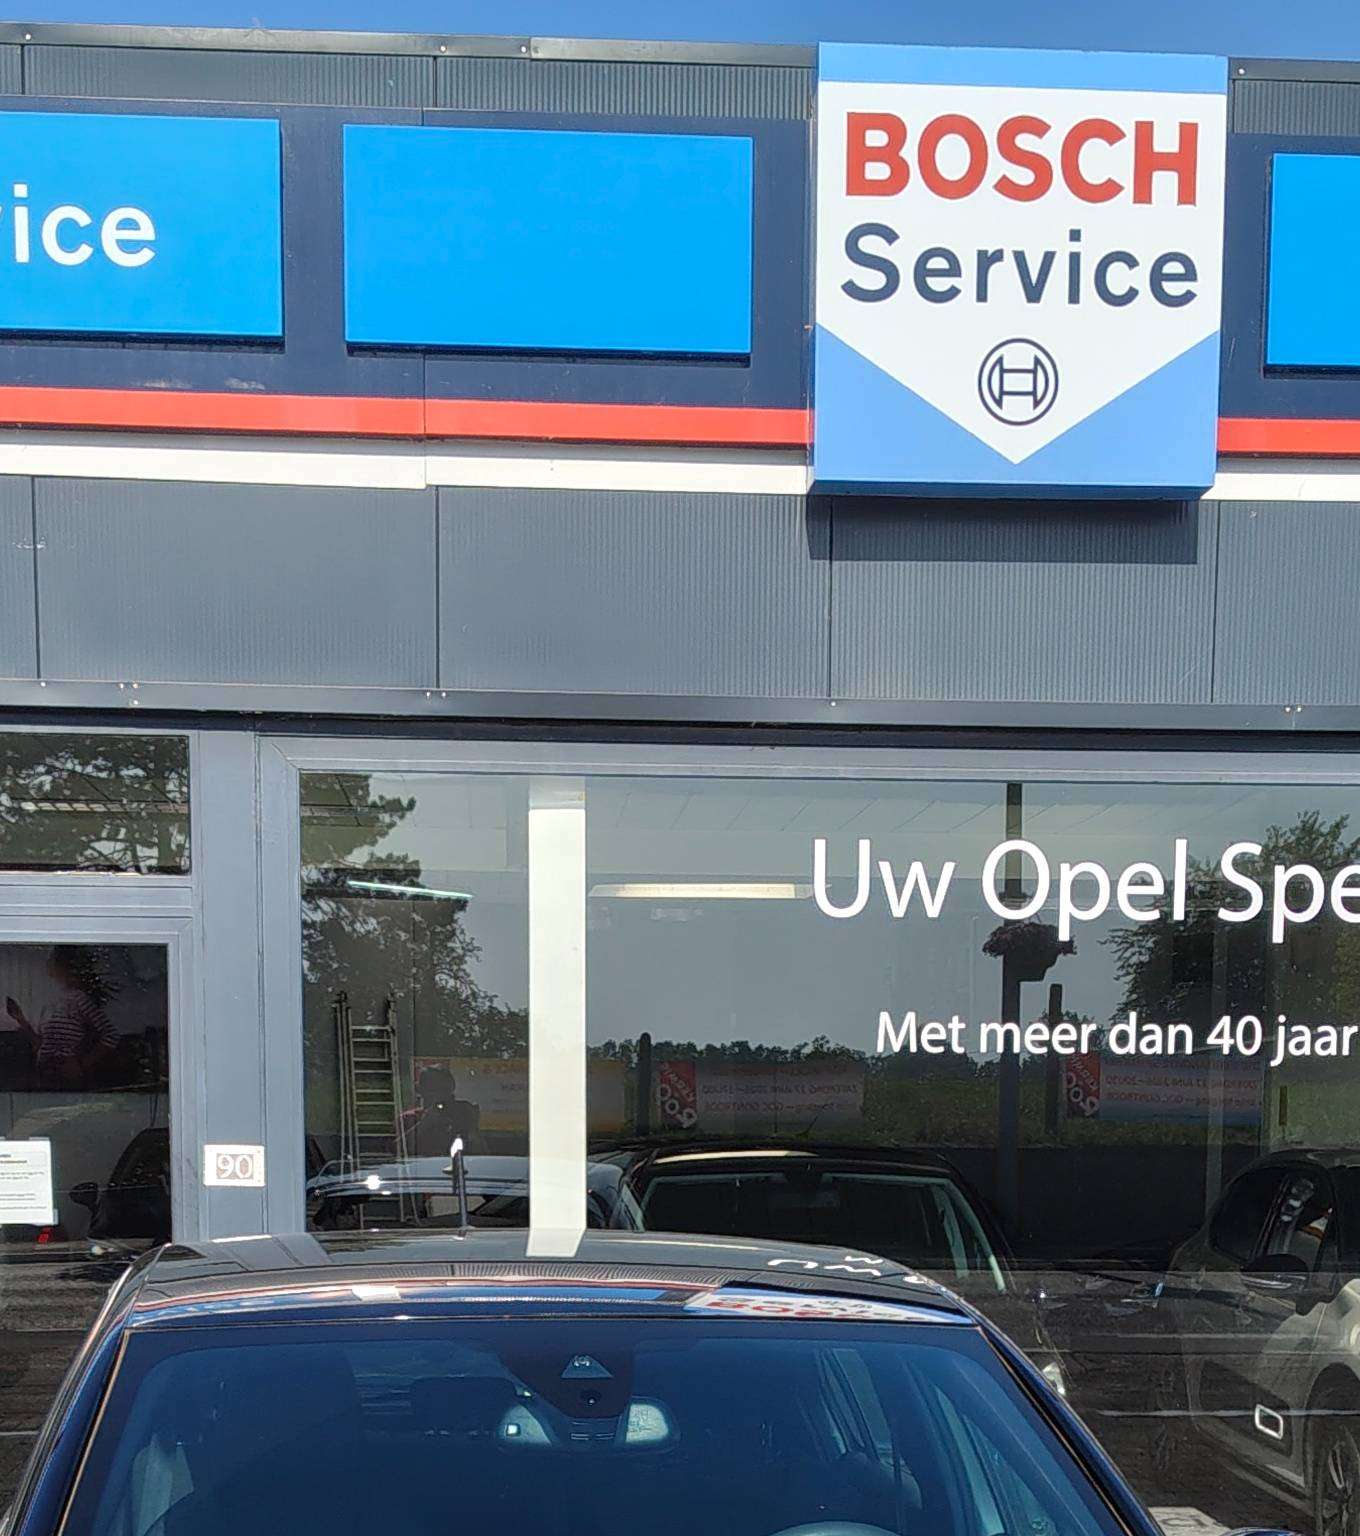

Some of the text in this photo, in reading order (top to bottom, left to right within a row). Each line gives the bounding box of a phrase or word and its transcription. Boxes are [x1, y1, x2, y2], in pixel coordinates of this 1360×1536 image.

[846, 112, 1199, 206] BOSCH
[840, 222, 1198, 308] Service
[811, 838, 957, 920] Uw
[981, 837, 1189, 942] Opel
[876, 1010, 966, 1055] Met
[979, 1021, 1098, 1056] meer
[1108, 1011, 1194, 1056] dan
[1205, 1014, 1263, 1056] 40
[1269, 1014, 1359, 1067] jaar
[217, 1154, 253, 1179] 90
